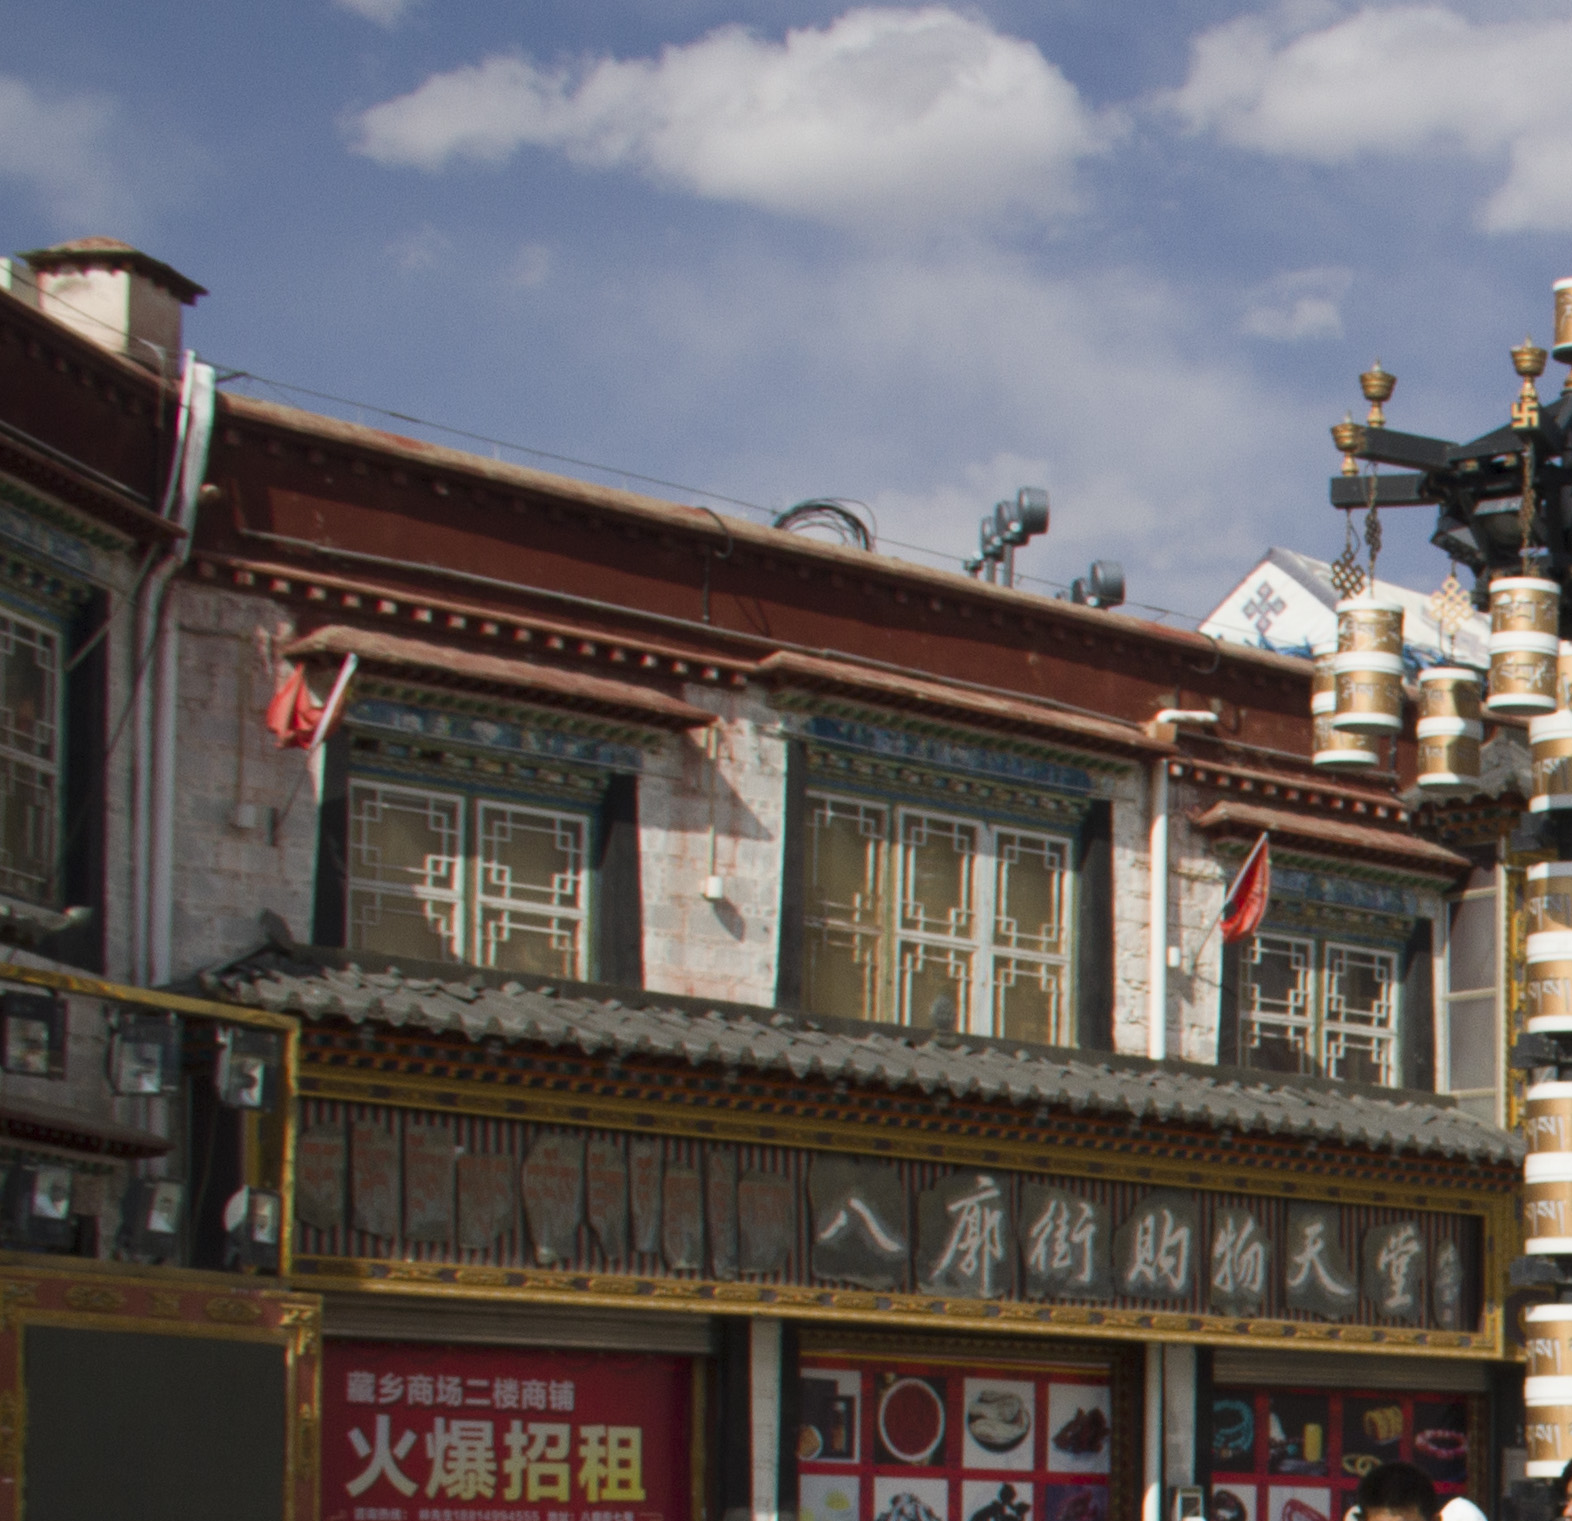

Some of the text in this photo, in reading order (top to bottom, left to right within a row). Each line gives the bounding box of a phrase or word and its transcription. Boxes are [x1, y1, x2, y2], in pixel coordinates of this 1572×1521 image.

[346, 1371, 576, 1412] 藏乡商场二楼商铺
[345, 1413, 647, 1503] 火爆招租
